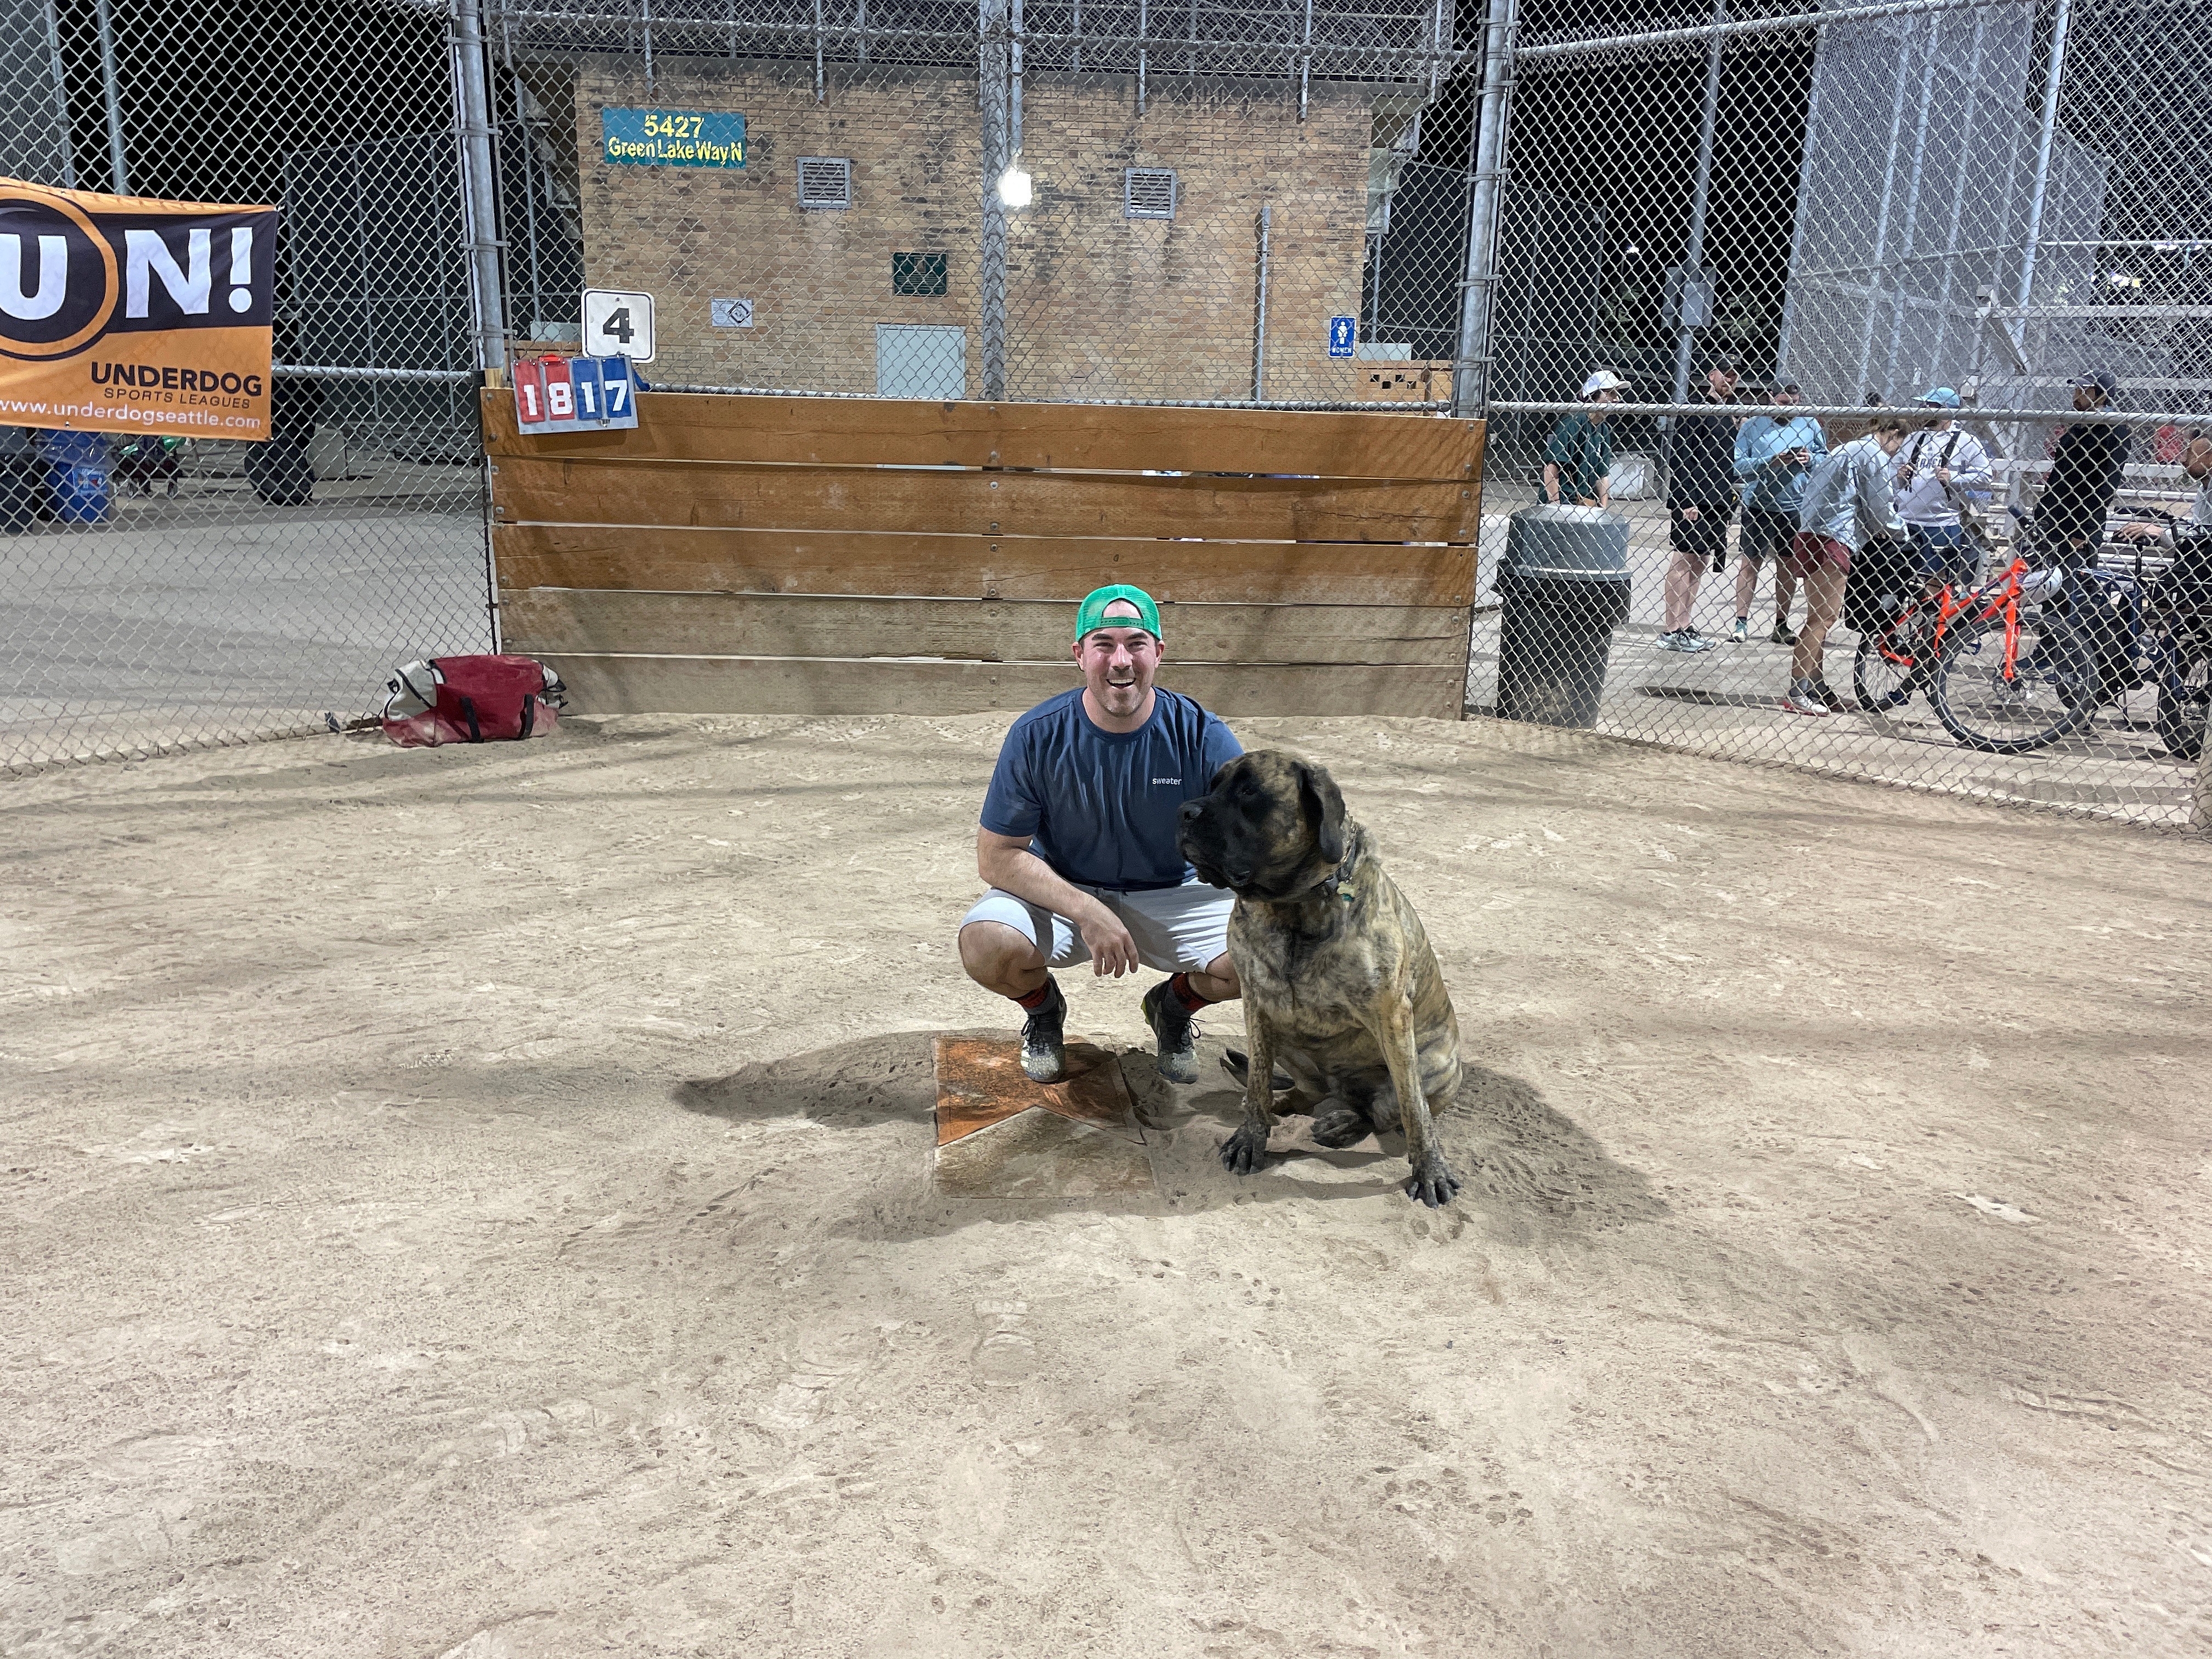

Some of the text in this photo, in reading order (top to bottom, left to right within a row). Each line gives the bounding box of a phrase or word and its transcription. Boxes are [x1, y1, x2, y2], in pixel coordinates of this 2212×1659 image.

[644, 114, 704, 138] 5427
[608, 136, 742, 165] Green Lake Way N
[603, 307, 634, 343] 4
[91, 361, 262, 397] UNDERDOG
[104, 387, 250, 409] SPORTS LEAGUES
[1152, 777, 1182, 785] sweater
